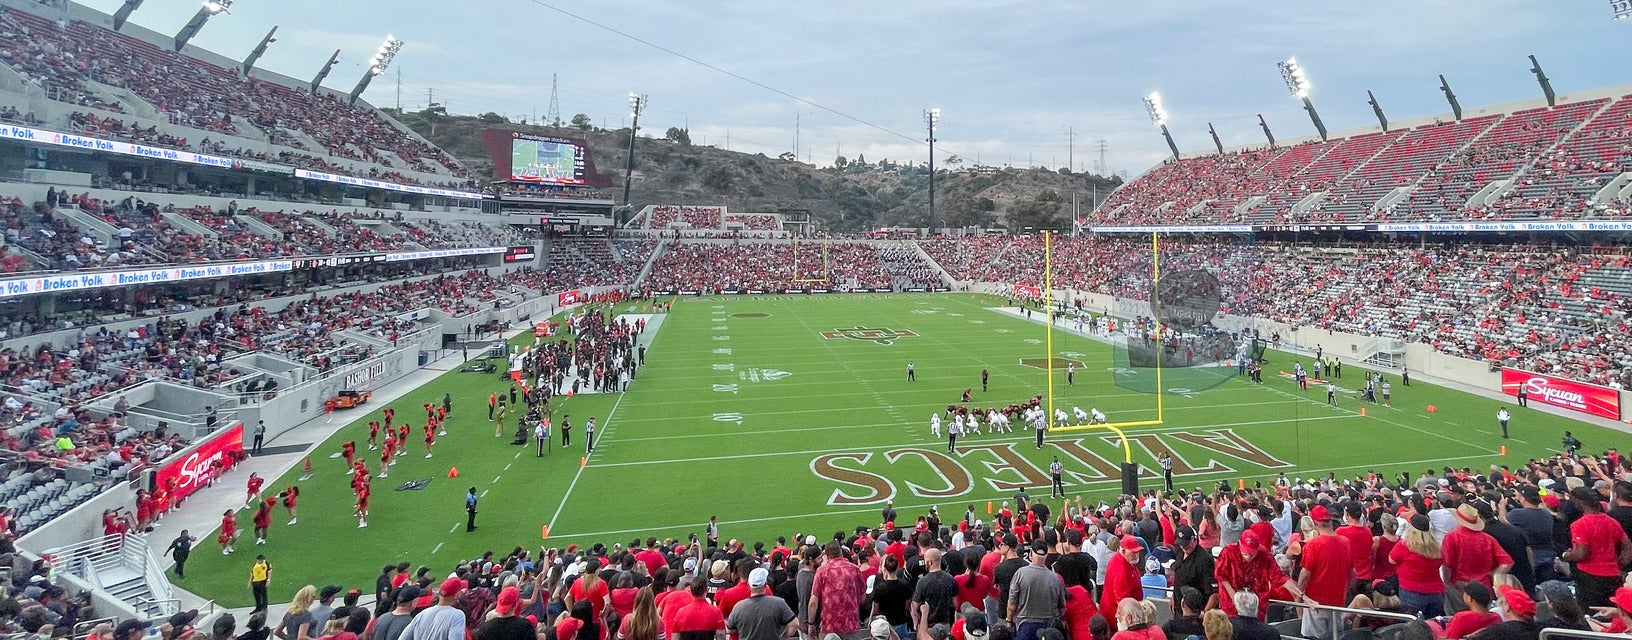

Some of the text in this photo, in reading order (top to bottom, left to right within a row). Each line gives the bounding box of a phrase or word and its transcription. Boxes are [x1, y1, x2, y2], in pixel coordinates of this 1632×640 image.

[11, 127, 34, 139] Yolk
[62, 135, 114, 150] Broken Yolk
[137, 146, 178, 159] Broken Yolk
[198, 155, 232, 166] Broken Yolk
[181, 266, 222, 278] Broken Yolk
[231, 263, 265, 273] Broken Yolk
[43, 275, 103, 290] Broken Yolk
[119, 271, 168, 283] Broken Yolk
[8, 281, 28, 294] Yolk
[1527, 377, 1584, 404] Sycuan
[180, 451, 223, 488] Sycuan
[810, 428, 1298, 506] AZTECS
